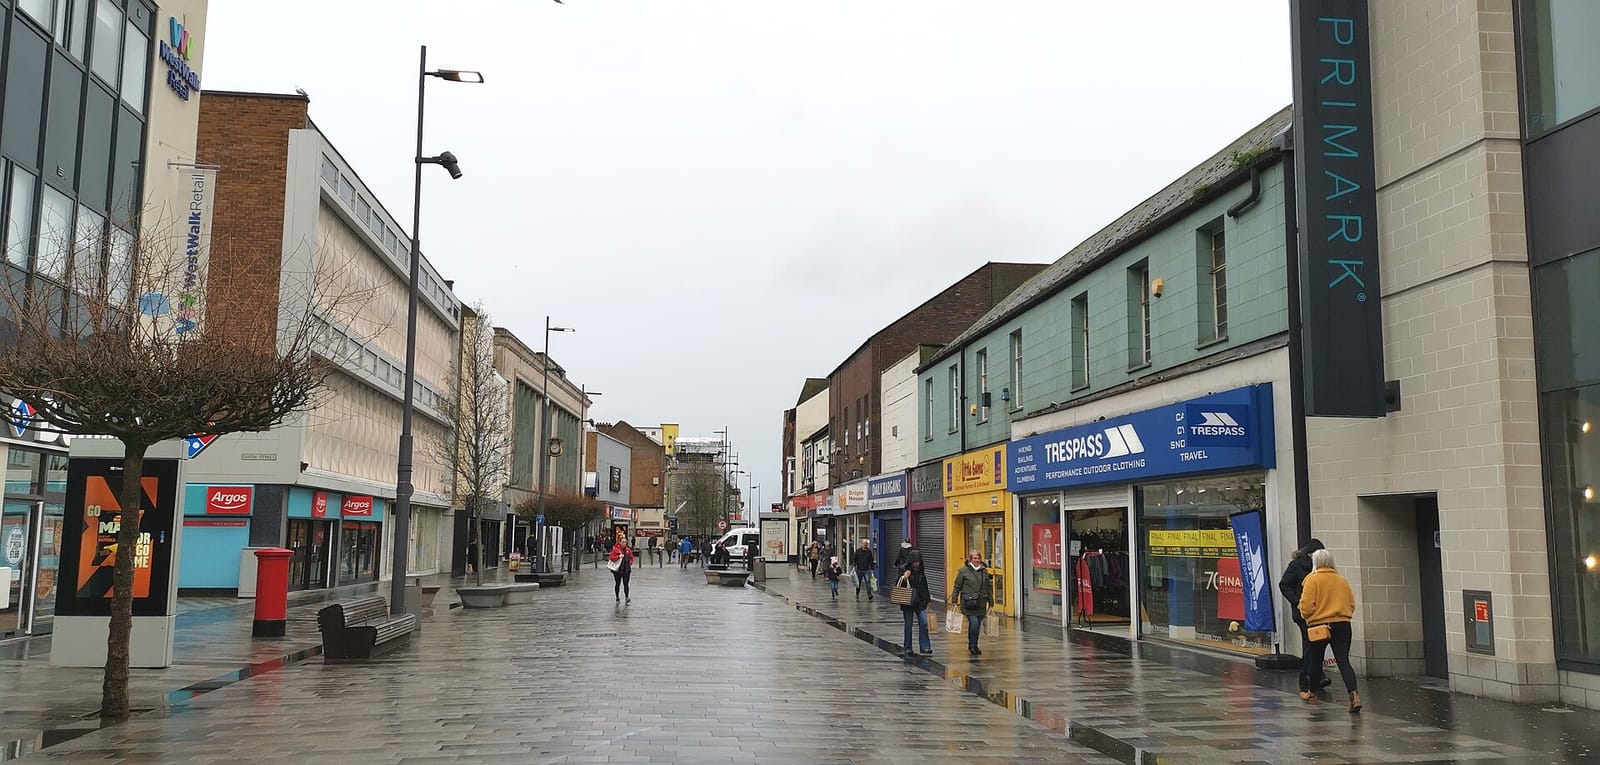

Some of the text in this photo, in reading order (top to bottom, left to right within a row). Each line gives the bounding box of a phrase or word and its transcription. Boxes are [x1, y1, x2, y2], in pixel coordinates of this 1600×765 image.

[160, 39, 200, 93] WestWalk
[167, 69, 190, 102] Retail
[1318, 17, 1365, 288] PRIMARK
[1190, 426, 1246, 436] TRESPASS
[1017, 445, 1033, 453] HIKING
[1044, 432, 1104, 464] TRESPASS
[1017, 454, 1034, 464] SAILING
[1180, 450, 1208, 462] TRAVEL
[1014, 463, 1038, 474] ADVENTURE
[1045, 458, 1146, 480] PERFORMANCE OUTDOOR CLOTHING
[1016, 474, 1036, 484] CLIMBING
[871, 482, 883, 496] DAILY
[882, 479, 902, 495] BARGAINS
[211, 491, 248, 505] Argos
[87, 504, 101, 517] GO
[343, 500, 370, 510] Argos
[98, 521, 121, 534] MA
[1220, 532, 1235, 541] FINA
[135, 544, 150, 556] GO
[1036, 543, 1061, 565] SALE
[1241, 532, 1258, 611] TRESPASS
[1219, 576, 1242, 587] FINA
